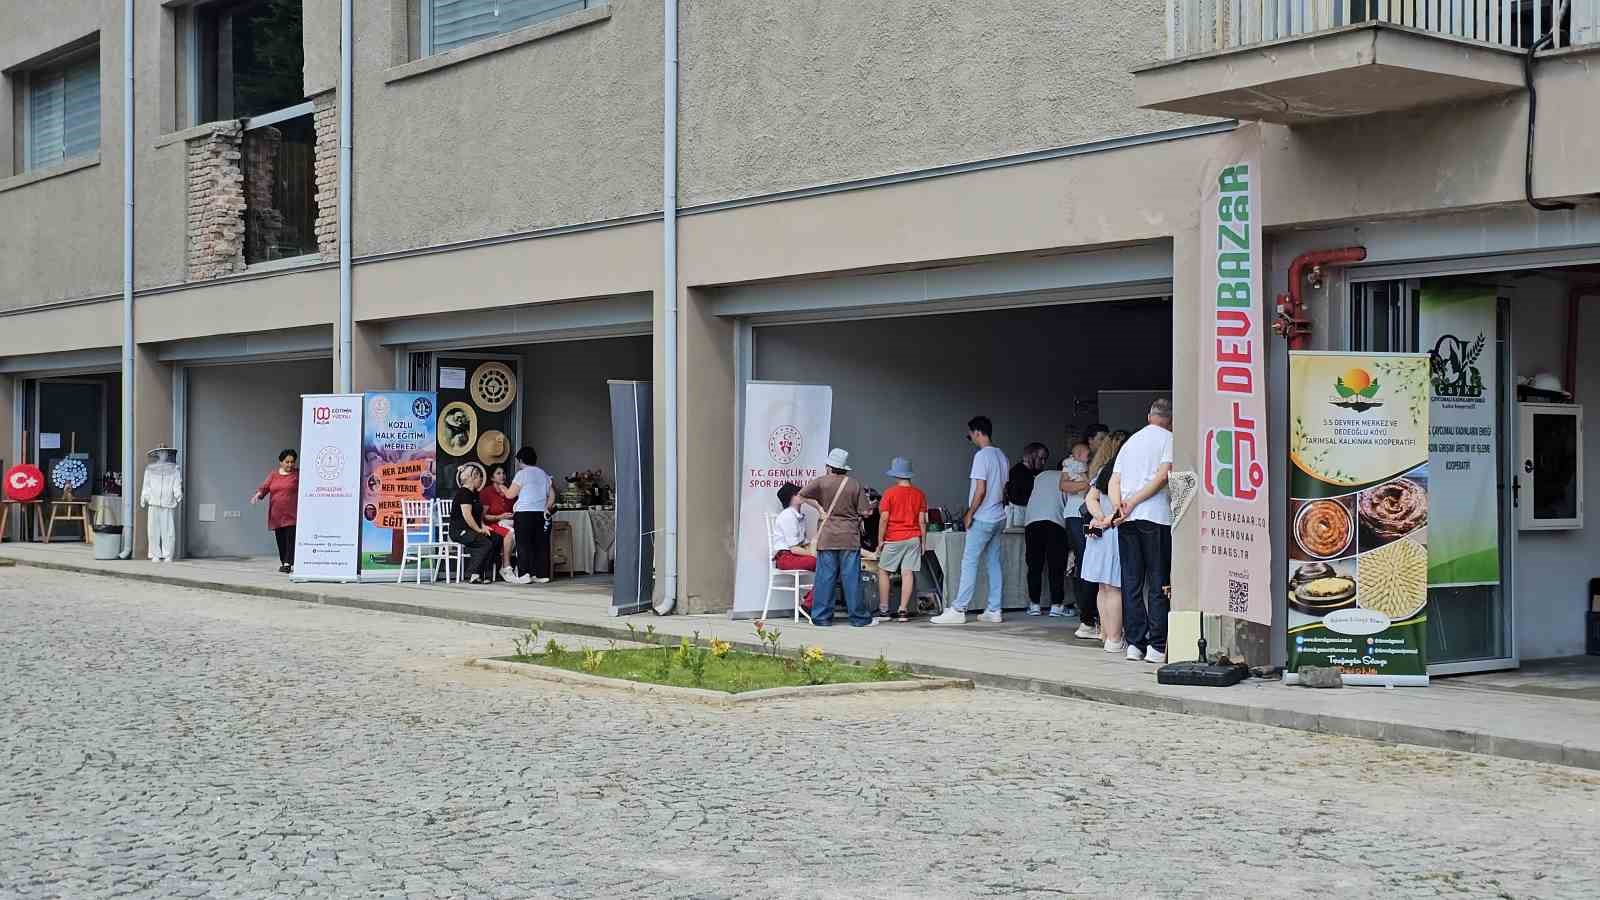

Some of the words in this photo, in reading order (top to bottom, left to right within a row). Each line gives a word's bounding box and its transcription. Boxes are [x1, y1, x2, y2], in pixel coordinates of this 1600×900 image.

[388, 421, 413, 429] KOZLU
[382, 468, 396, 477] HER
[397, 464, 422, 475] ZAMAN
[767, 467, 804, 479] GENÇLİK
[806, 469, 817, 477] VE
[381, 483, 395, 492] HER
[397, 485, 417, 493] YERDE
[750, 479, 771, 488] SPOR
